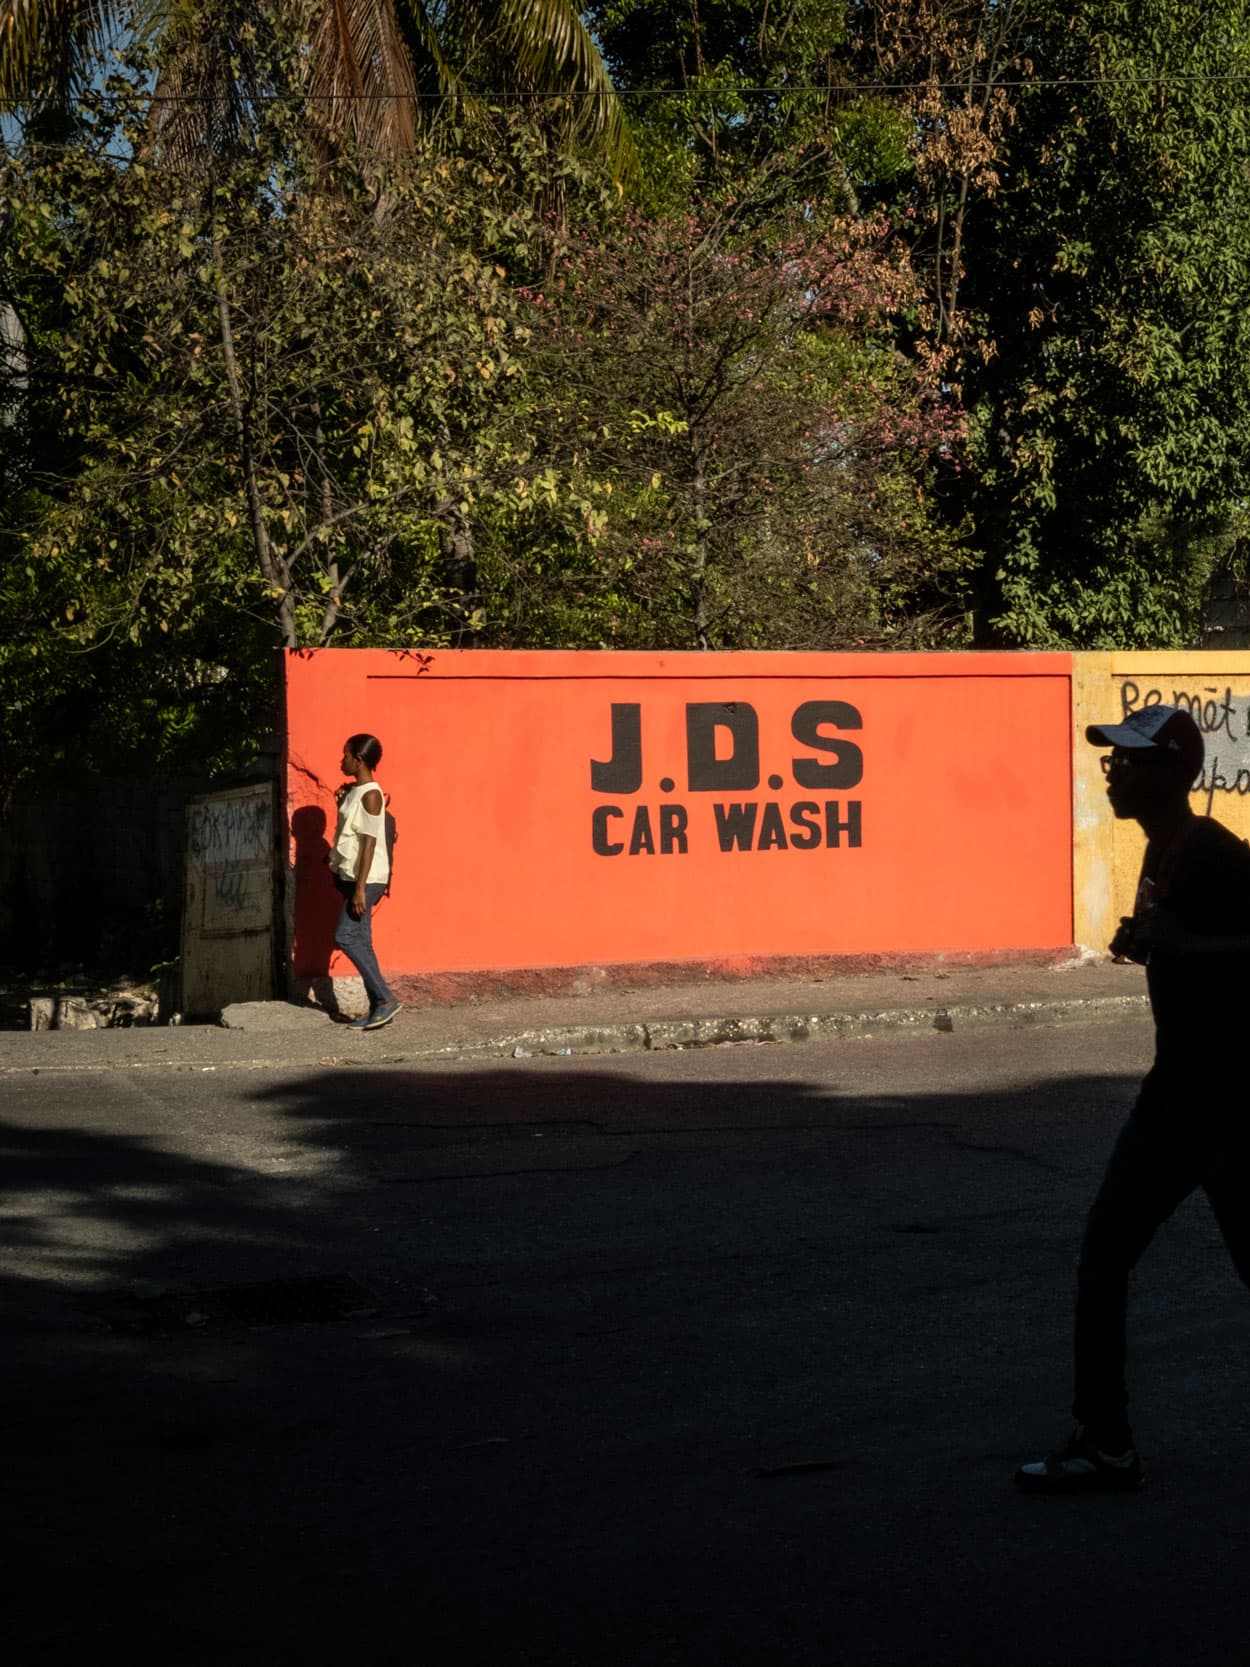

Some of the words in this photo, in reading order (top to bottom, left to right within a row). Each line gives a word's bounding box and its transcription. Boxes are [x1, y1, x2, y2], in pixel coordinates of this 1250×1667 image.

[590, 700, 863, 794] J.D.S
[592, 804, 689, 856] CAR
[713, 800, 862, 853] WASH
